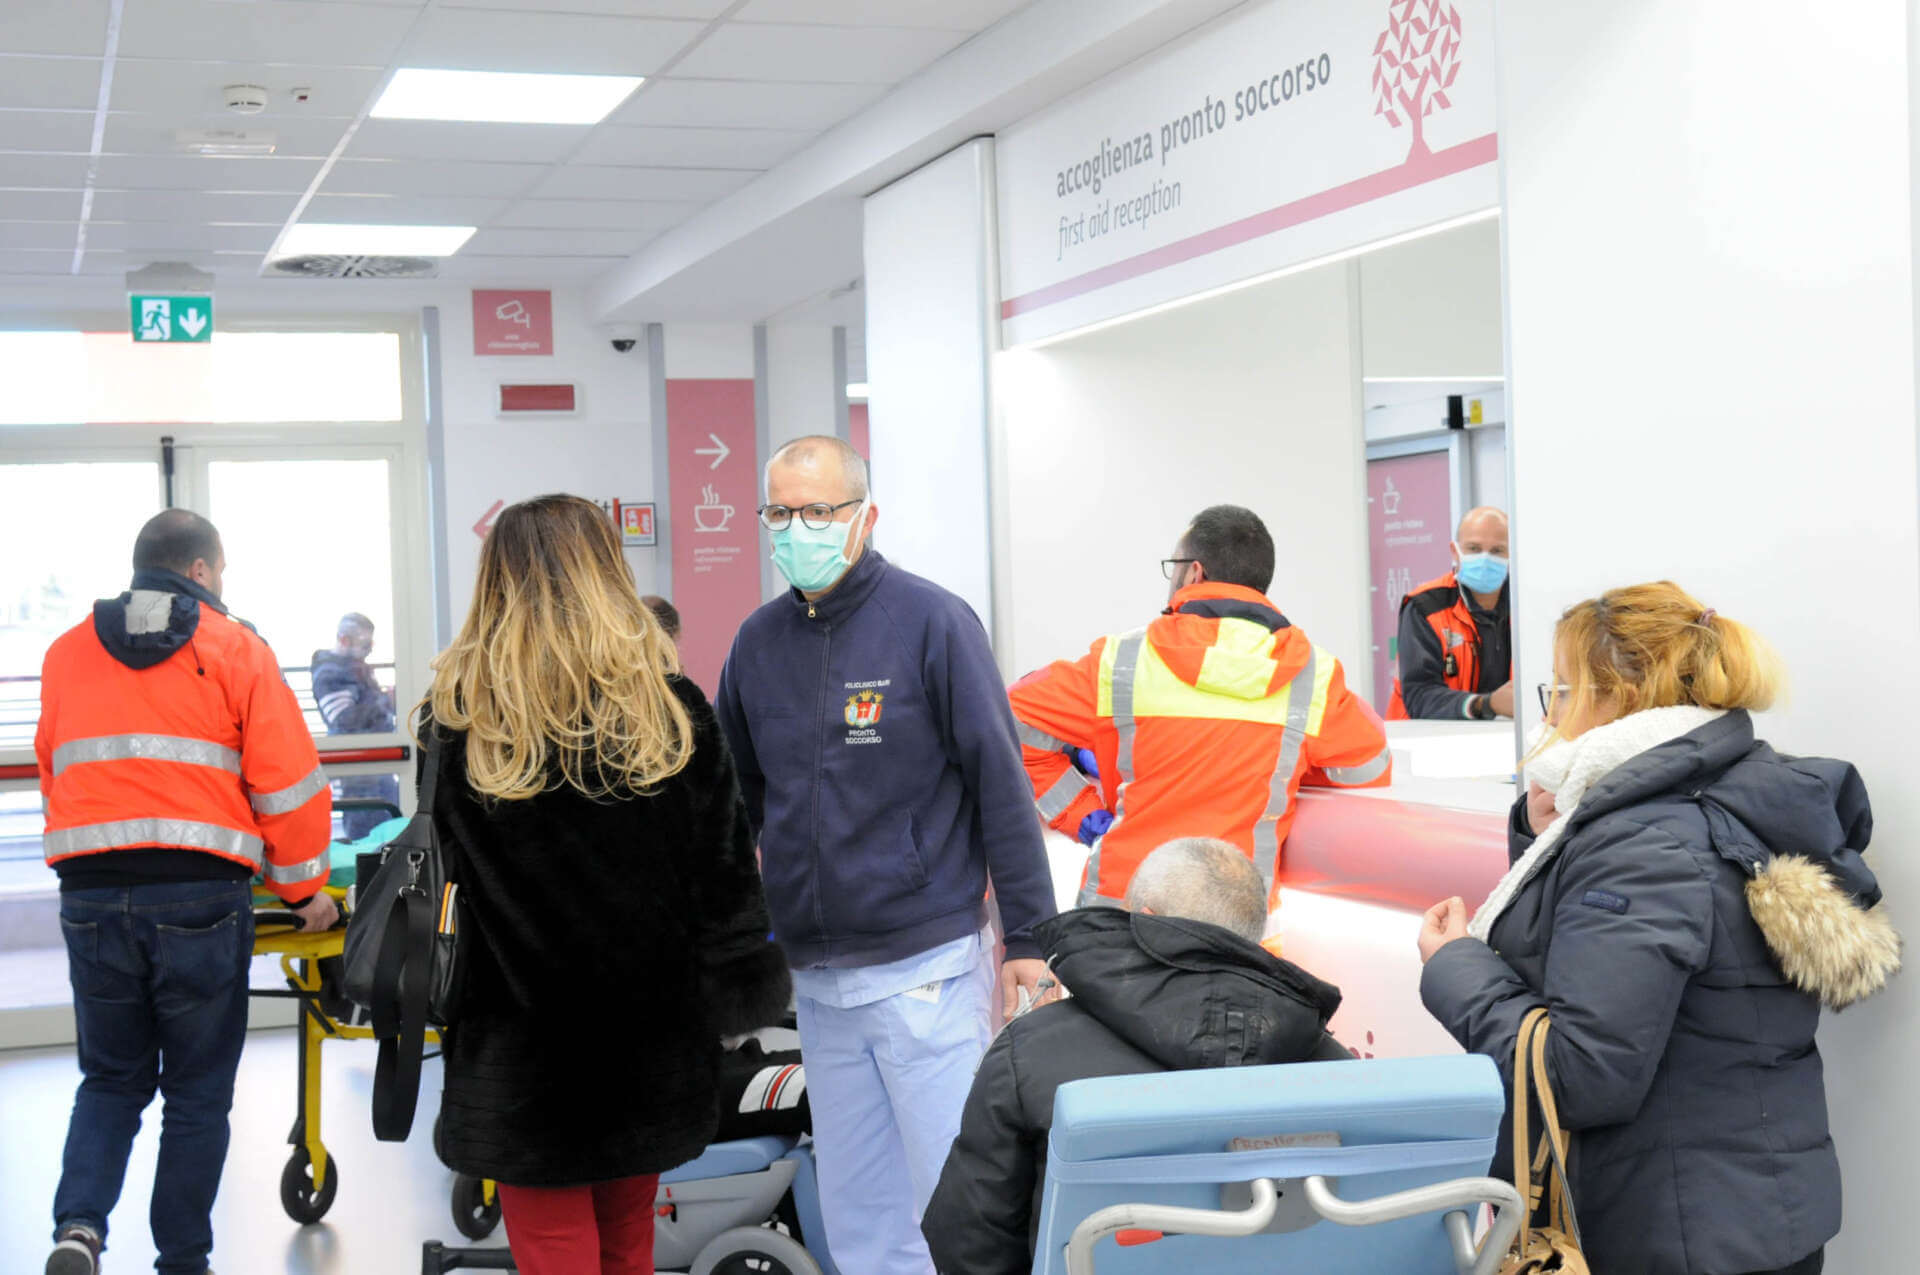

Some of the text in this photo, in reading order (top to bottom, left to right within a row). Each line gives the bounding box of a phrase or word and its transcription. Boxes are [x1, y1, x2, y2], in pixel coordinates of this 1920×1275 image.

[1056, 53, 1331, 198] accoglienza pronto soccorso
[1057, 179, 1182, 262] first aid reception
